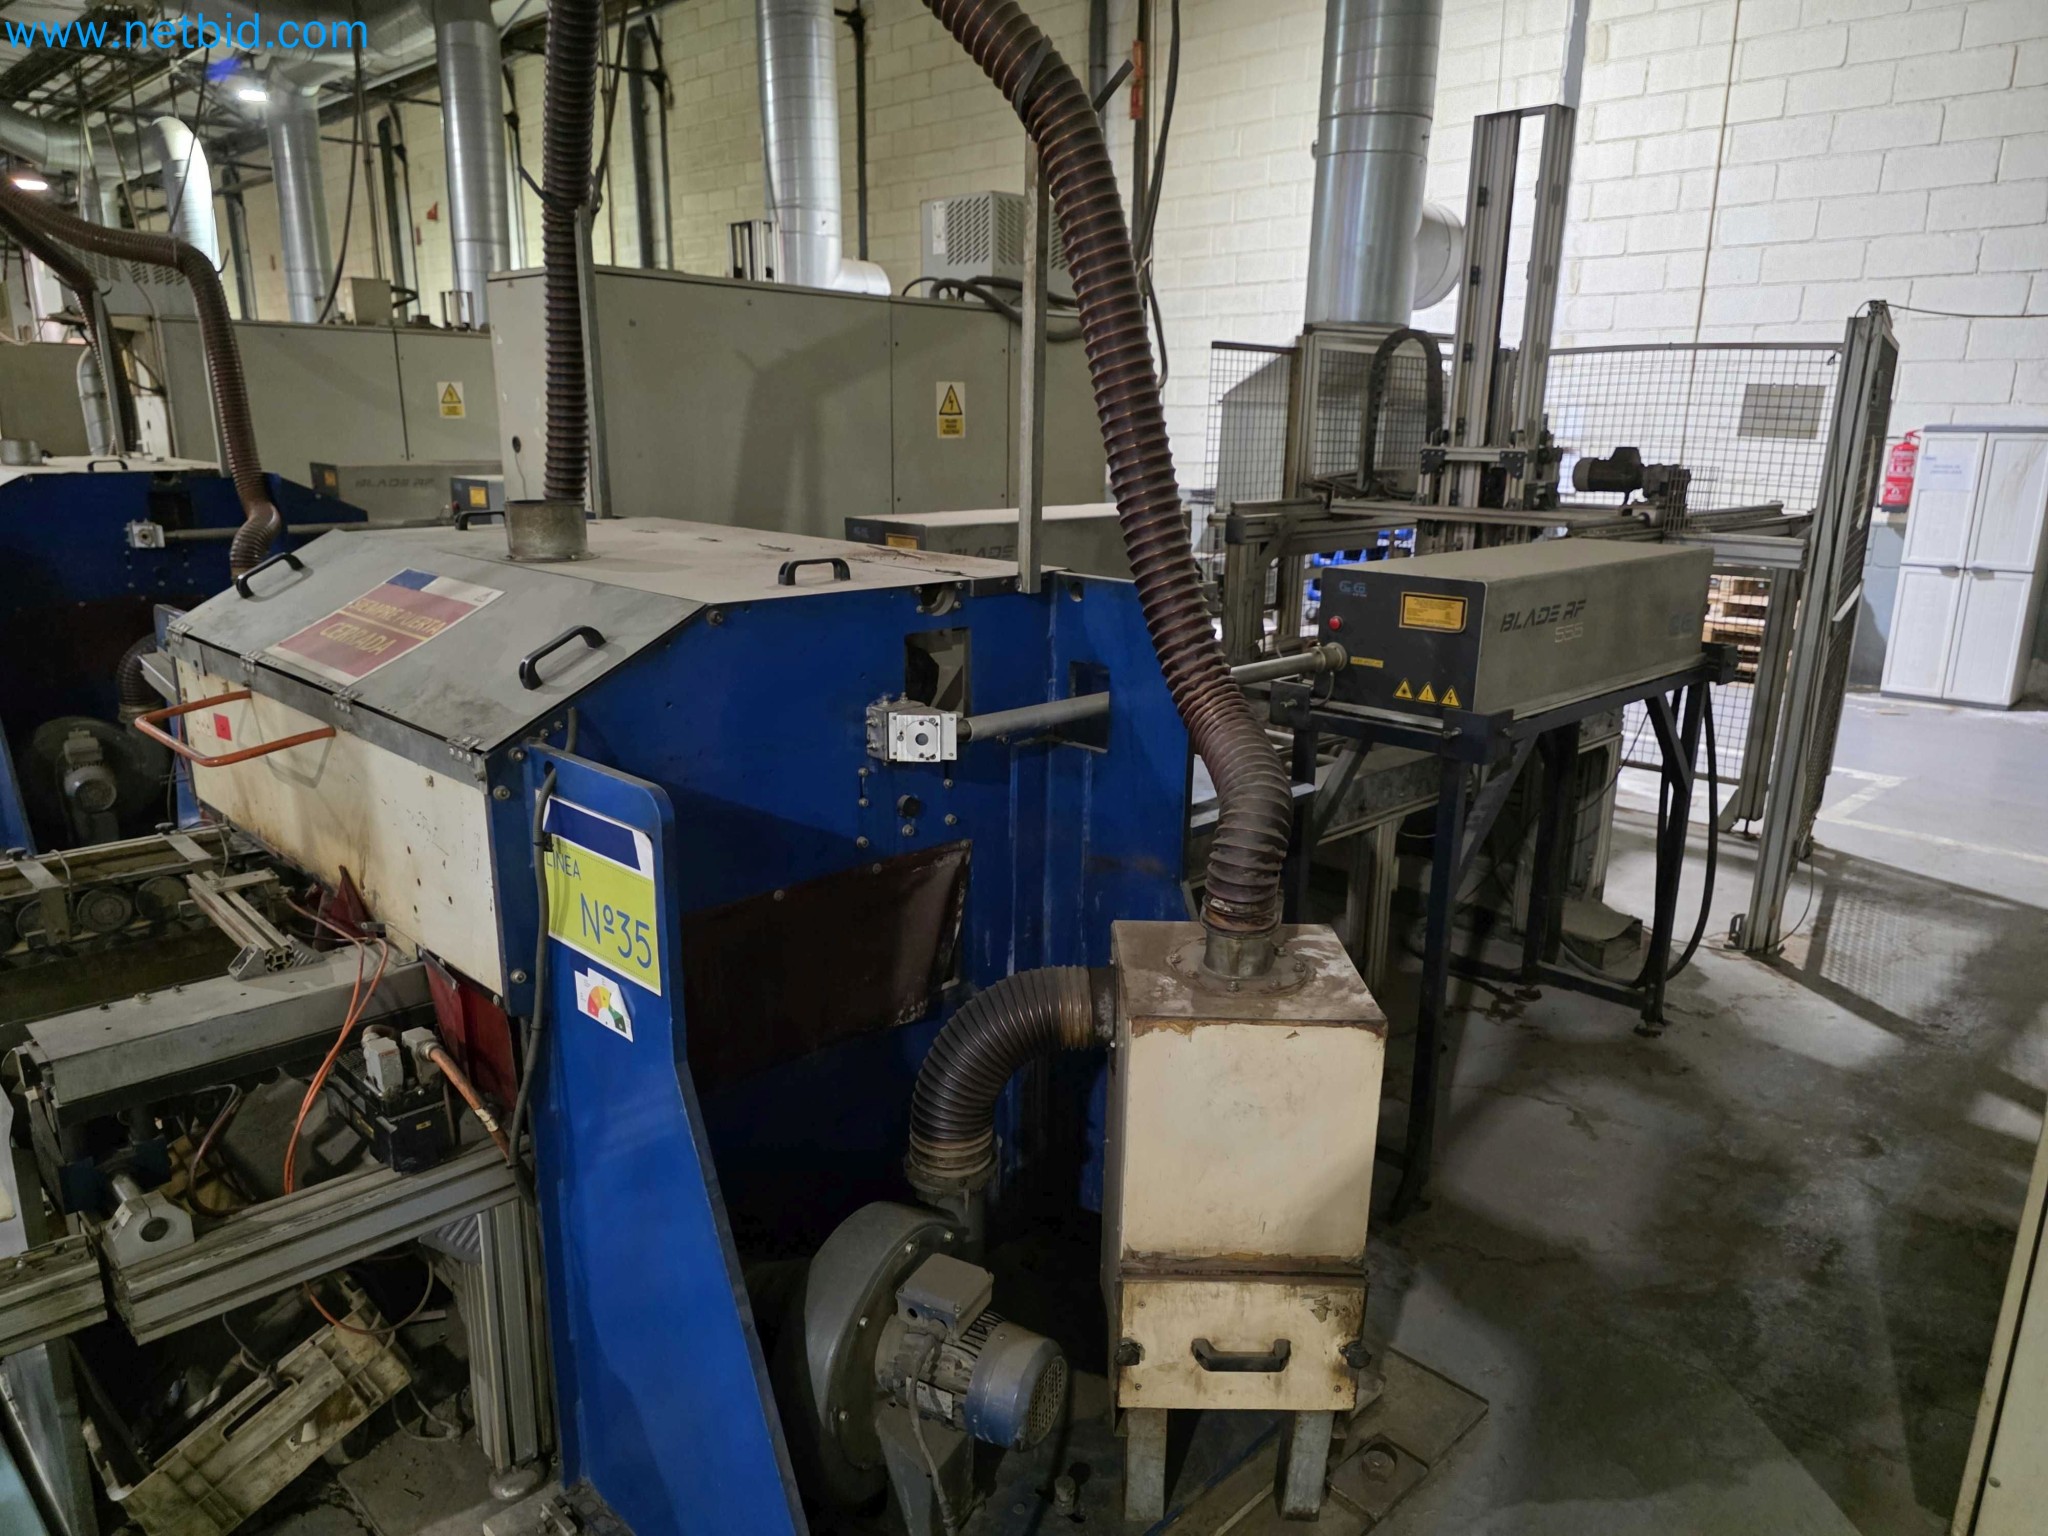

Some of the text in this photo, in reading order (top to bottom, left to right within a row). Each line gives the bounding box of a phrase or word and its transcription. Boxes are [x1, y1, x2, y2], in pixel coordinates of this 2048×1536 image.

[398, 611, 447, 635] PUERTA
[1500, 600, 1587, 632] BLADE RF
[319, 622, 397, 656] CERRADA
